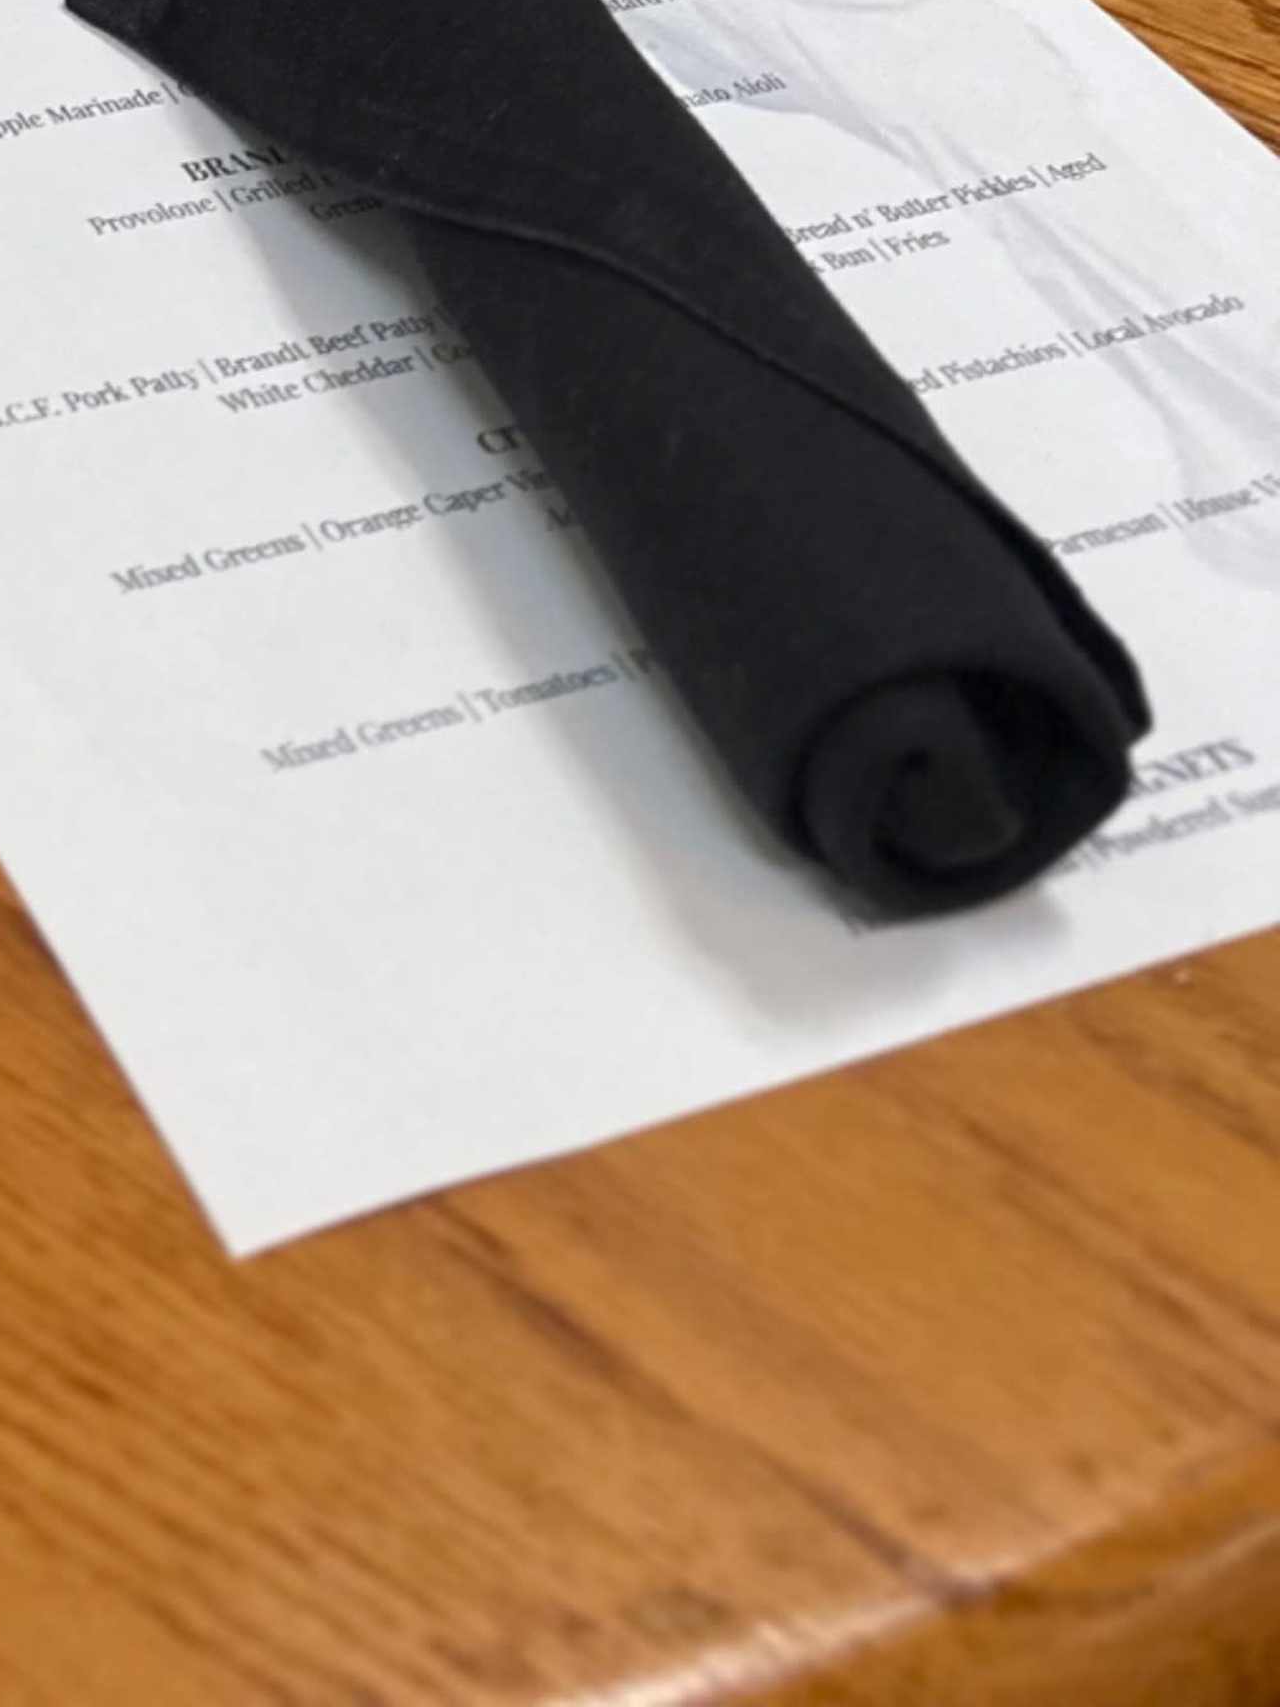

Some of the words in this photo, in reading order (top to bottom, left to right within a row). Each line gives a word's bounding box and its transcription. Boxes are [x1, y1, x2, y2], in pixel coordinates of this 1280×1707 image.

[45, 87, 163, 125] Marinade
[87, 193, 215, 236] Provolone
[877, 193, 950, 224] Butter
[952, 172, 1037, 206] Pickles
[1046, 153, 1107, 185] Aged
[890, 227, 950, 256] Fries
[64, 383, 125, 414] Pork
[130, 363, 200, 401] Patty
[214, 340, 308, 380] Brandt
[308, 321, 369, 357] Beef
[942, 342, 1065, 388] Pistachios
[1073, 319, 1144, 351] Local
[1143, 292, 1245, 335] Avocado
[218, 379, 301, 414] White
[302, 353, 416, 396] Cheddar
[109, 554, 201, 594] Mixed
[203, 530, 306, 573] Greens
[319, 502, 424, 544] Orange
